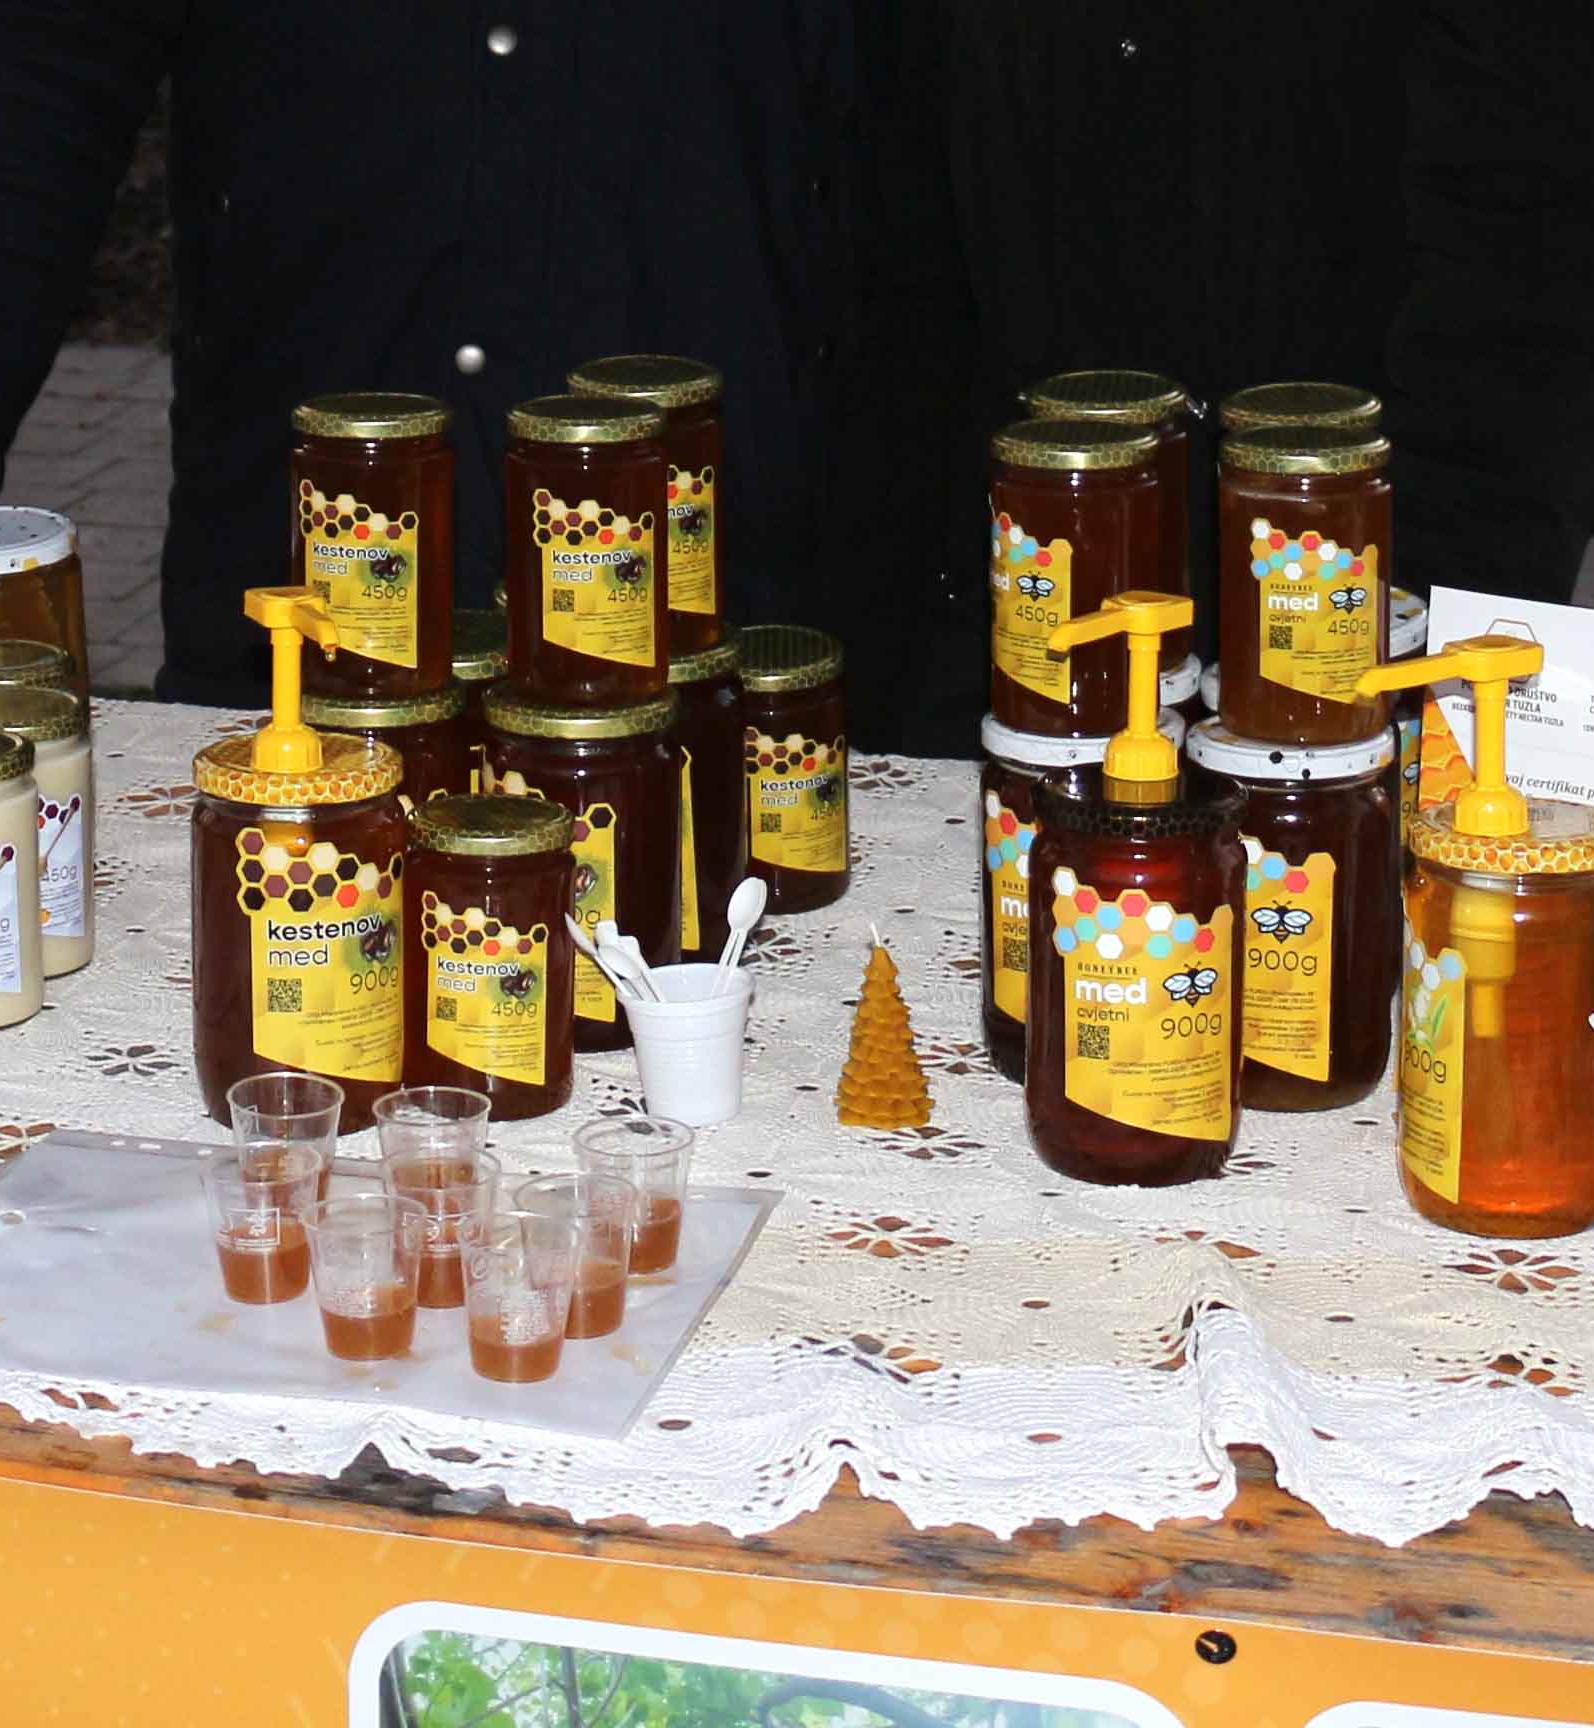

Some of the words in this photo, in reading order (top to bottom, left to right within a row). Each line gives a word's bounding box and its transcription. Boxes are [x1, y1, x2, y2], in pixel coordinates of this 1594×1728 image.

[313, 542, 390, 560] kestenov
[552, 550, 631, 565] kestenov
[313, 560, 348, 575] med
[552, 567, 593, 582] med
[361, 585, 408, 601] 450g
[607, 588, 648, 603] 450g
[1268, 592, 1319, 611] med
[1016, 605, 1058, 627] 450g
[1327, 618, 1369, 636] 450g
[1512, 700, 1541, 713] TUZLA
[1526, 775, 1585, 796] certifikat
[268, 914, 382, 941] kestenov
[268, 944, 329, 966] med
[1248, 948, 1318, 976] 900g
[437, 955, 519, 976] kestenov
[349, 966, 399, 994] 900g
[437, 976, 476, 992] med
[1075, 977, 1148, 1004] med
[492, 1001, 538, 1017] 450g
[1076, 1006, 1129, 1022] cvjetni
[1161, 1013, 1222, 1040] 900g
